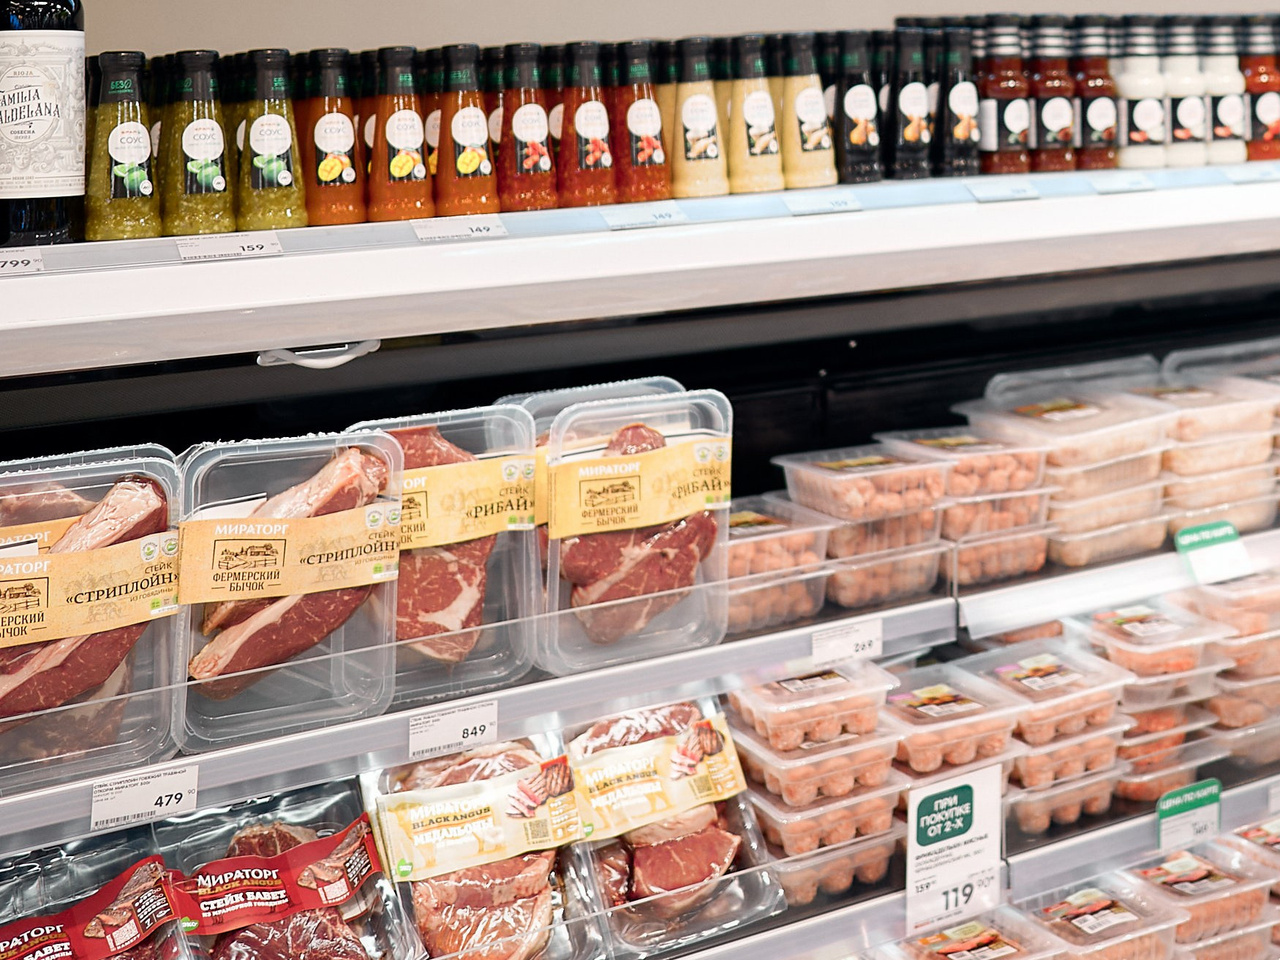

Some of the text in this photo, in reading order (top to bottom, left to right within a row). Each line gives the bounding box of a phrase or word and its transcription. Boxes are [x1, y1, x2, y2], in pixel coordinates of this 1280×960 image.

[0, 88, 40, 107] AMILIA
[193, 133, 217, 141] СОУС
[259, 128, 283, 136] СОУС
[120, 136, 143, 144] СОУС
[468, 225, 490, 234] 149
[240, 244, 264, 252] 159
[0, 259, 31, 268] 799
[578, 461, 641, 478] МИРАТОРГ
[692, 467, 722, 478] СТЕЙК
[498, 484, 530, 497] СТЕЙК
[671, 477, 730, 500] «РИБАЙ»
[581, 503, 639, 518] ФЕРМЕРСКИЙ
[596, 516, 626, 527] БЫЧОК
[214, 523, 289, 536] МИРАТОРГ
[368, 530, 396, 541] СТЕЙК
[144, 561, 173, 575] СТЕЙК
[212, 568, 280, 583] ФЕРМЕРСКИЙ
[66, 572, 179, 605] «СТРИПЛОЙН»
[229, 581, 264, 592] БЫЧОК
[462, 724, 487, 739] 849
[588, 769, 658, 794] BLACK ANGUS
[154, 792, 183, 808] 479
[933, 794, 958, 811] ПРИ
[412, 806, 491, 830] BLACK ANGUS
[920, 802, 971, 828] ПОКУПКЕ
[927, 817, 964, 838] ОТ 2-Х
[197, 868, 279, 888] МИРАТОРГ
[198, 878, 283, 896] BLACK ANGUS
[200, 889, 286, 911] СТЕЙК БАВЕТ
[942, 882, 974, 911] 119
[212, 901, 253, 917] МРАМОРНОЙ
[20, 932, 67, 952] ANGUS
